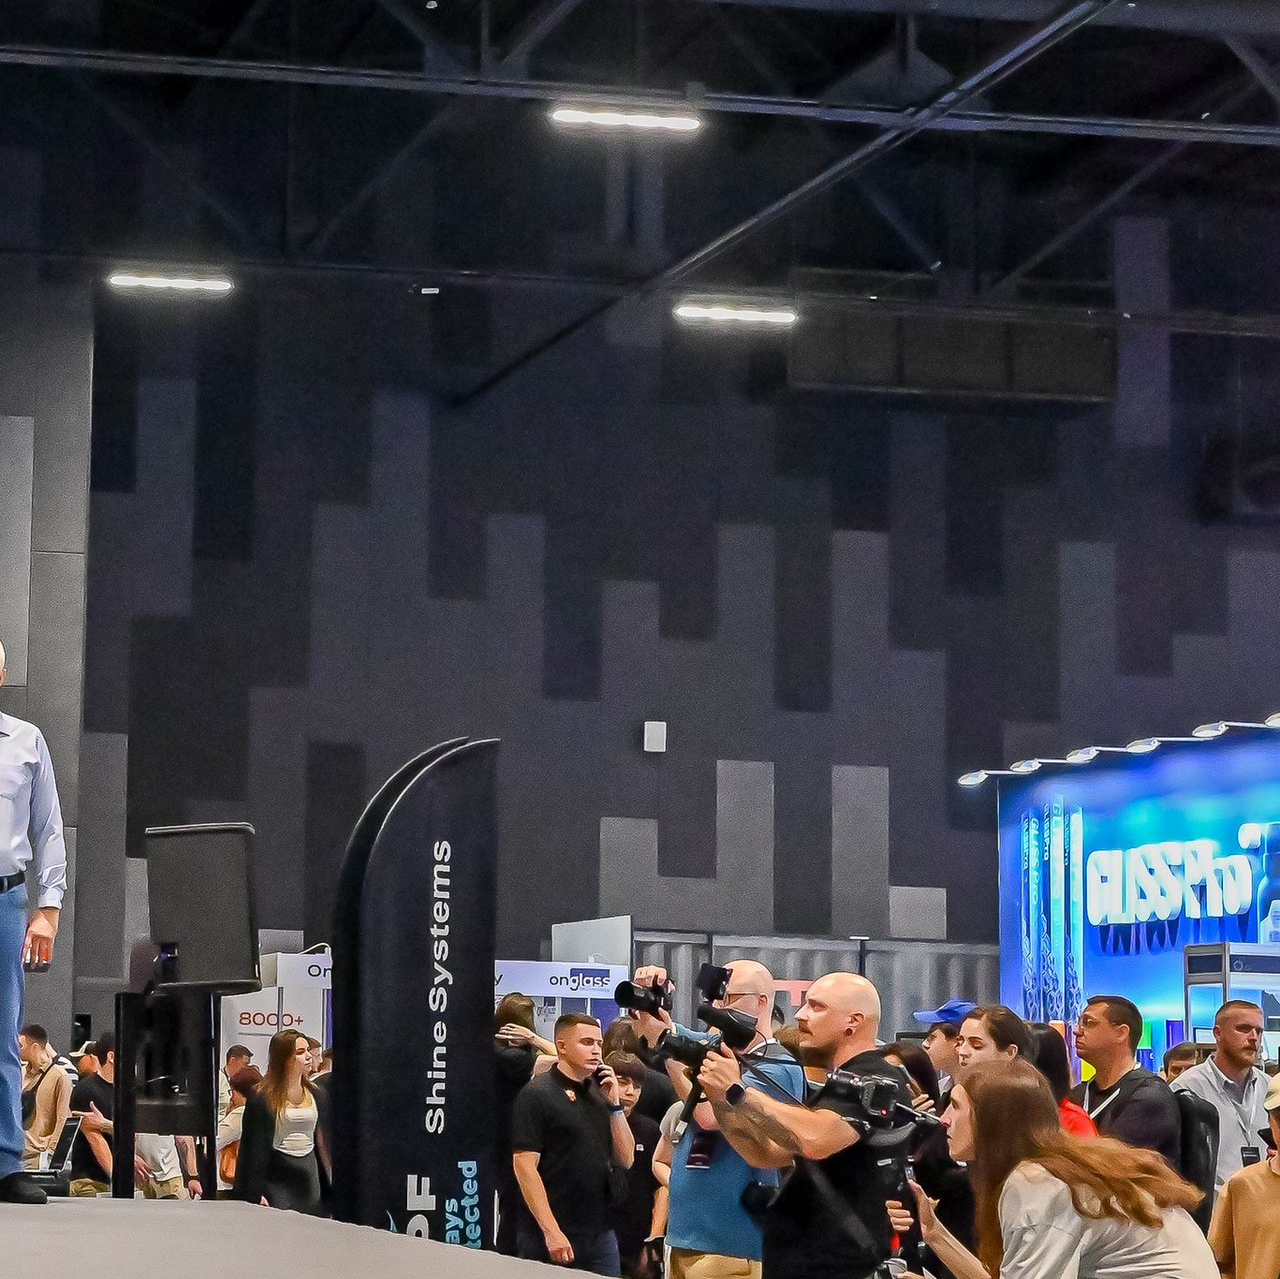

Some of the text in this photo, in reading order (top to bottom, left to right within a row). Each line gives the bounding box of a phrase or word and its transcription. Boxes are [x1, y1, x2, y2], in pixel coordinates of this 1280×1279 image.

[425, 839, 453, 1135] Shine Systems
[549, 972, 611, 992] onglass
[238, 1011, 305, 1027] 8000+
